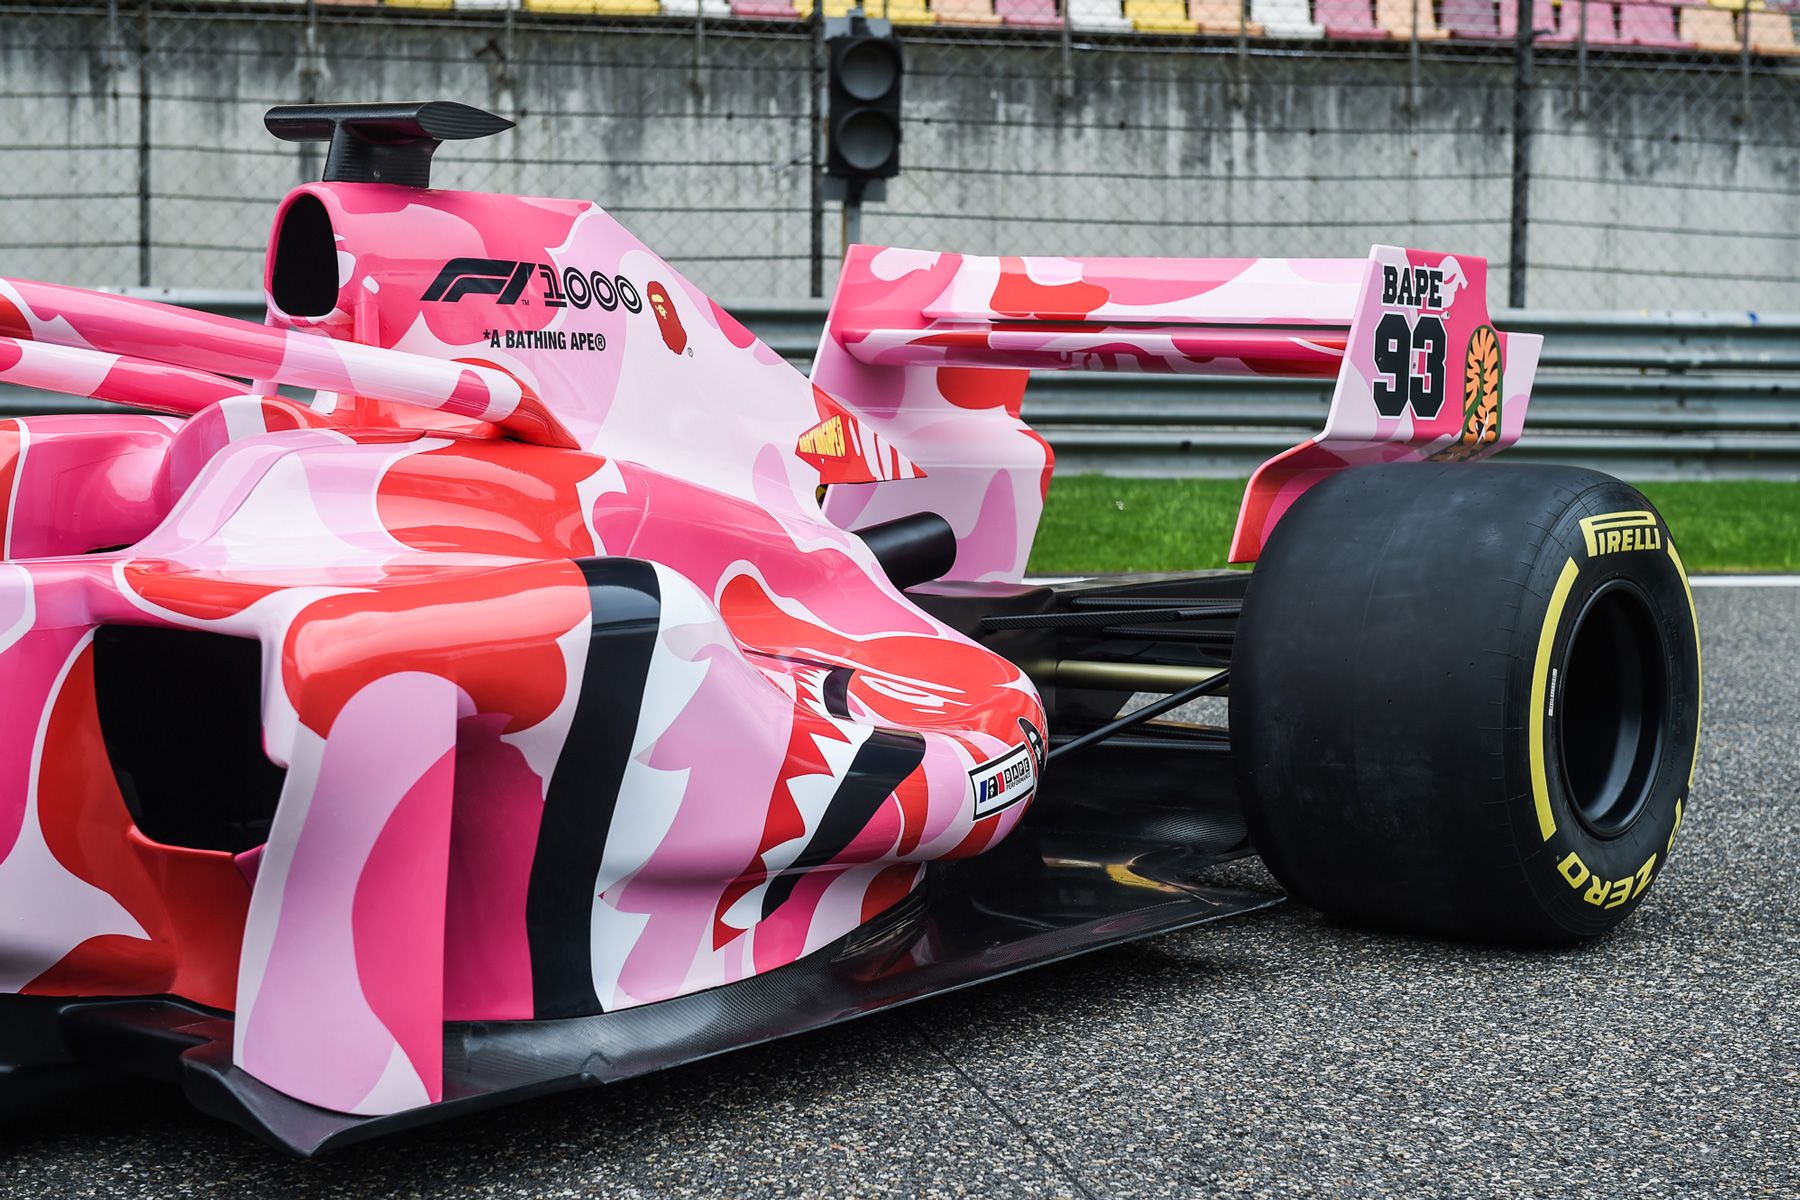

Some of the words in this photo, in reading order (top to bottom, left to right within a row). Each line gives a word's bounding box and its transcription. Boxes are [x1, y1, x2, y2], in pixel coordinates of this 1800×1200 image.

[538, 263, 643, 315] 1000
[1382, 264, 1444, 311] BAPE
[505, 330, 567, 350] BATHING
[1372, 311, 1448, 420] 93
[1579, 510, 1661, 557] PIRELLI
[1004, 757, 1031, 784] BAPE
[1557, 851, 1657, 910] ZERO
